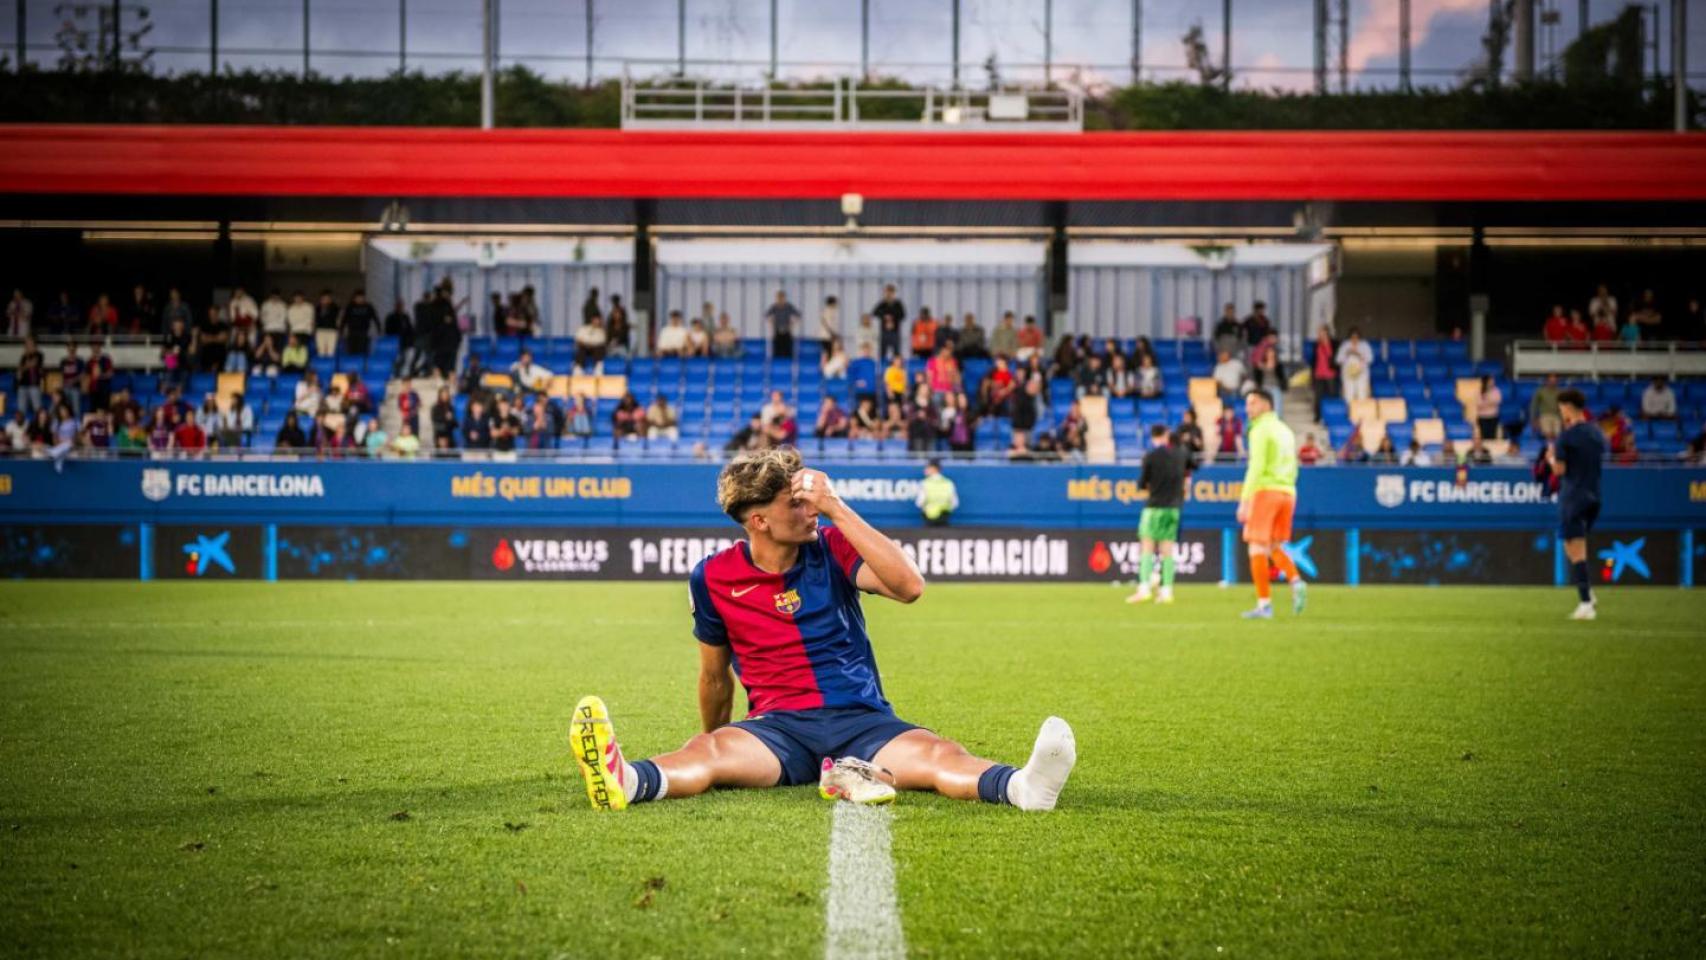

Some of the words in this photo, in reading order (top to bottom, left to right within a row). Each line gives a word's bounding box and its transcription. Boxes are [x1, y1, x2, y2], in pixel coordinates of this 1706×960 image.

[176, 474, 201, 496] FC
[204, 474, 325, 497] BARCELONA
[451, 471, 496, 498] MÉS
[499, 476, 541, 502] QUE
[544, 476, 575, 498] UN
[578, 477, 632, 499] CLUB
[1067, 475, 1113, 501] MÉS
[1410, 480, 1436, 503] FC
[514, 539, 609, 562] VERSUS
[917, 534, 1068, 576] FEDERACIÓN
[1108, 541, 1205, 564] VEUS
